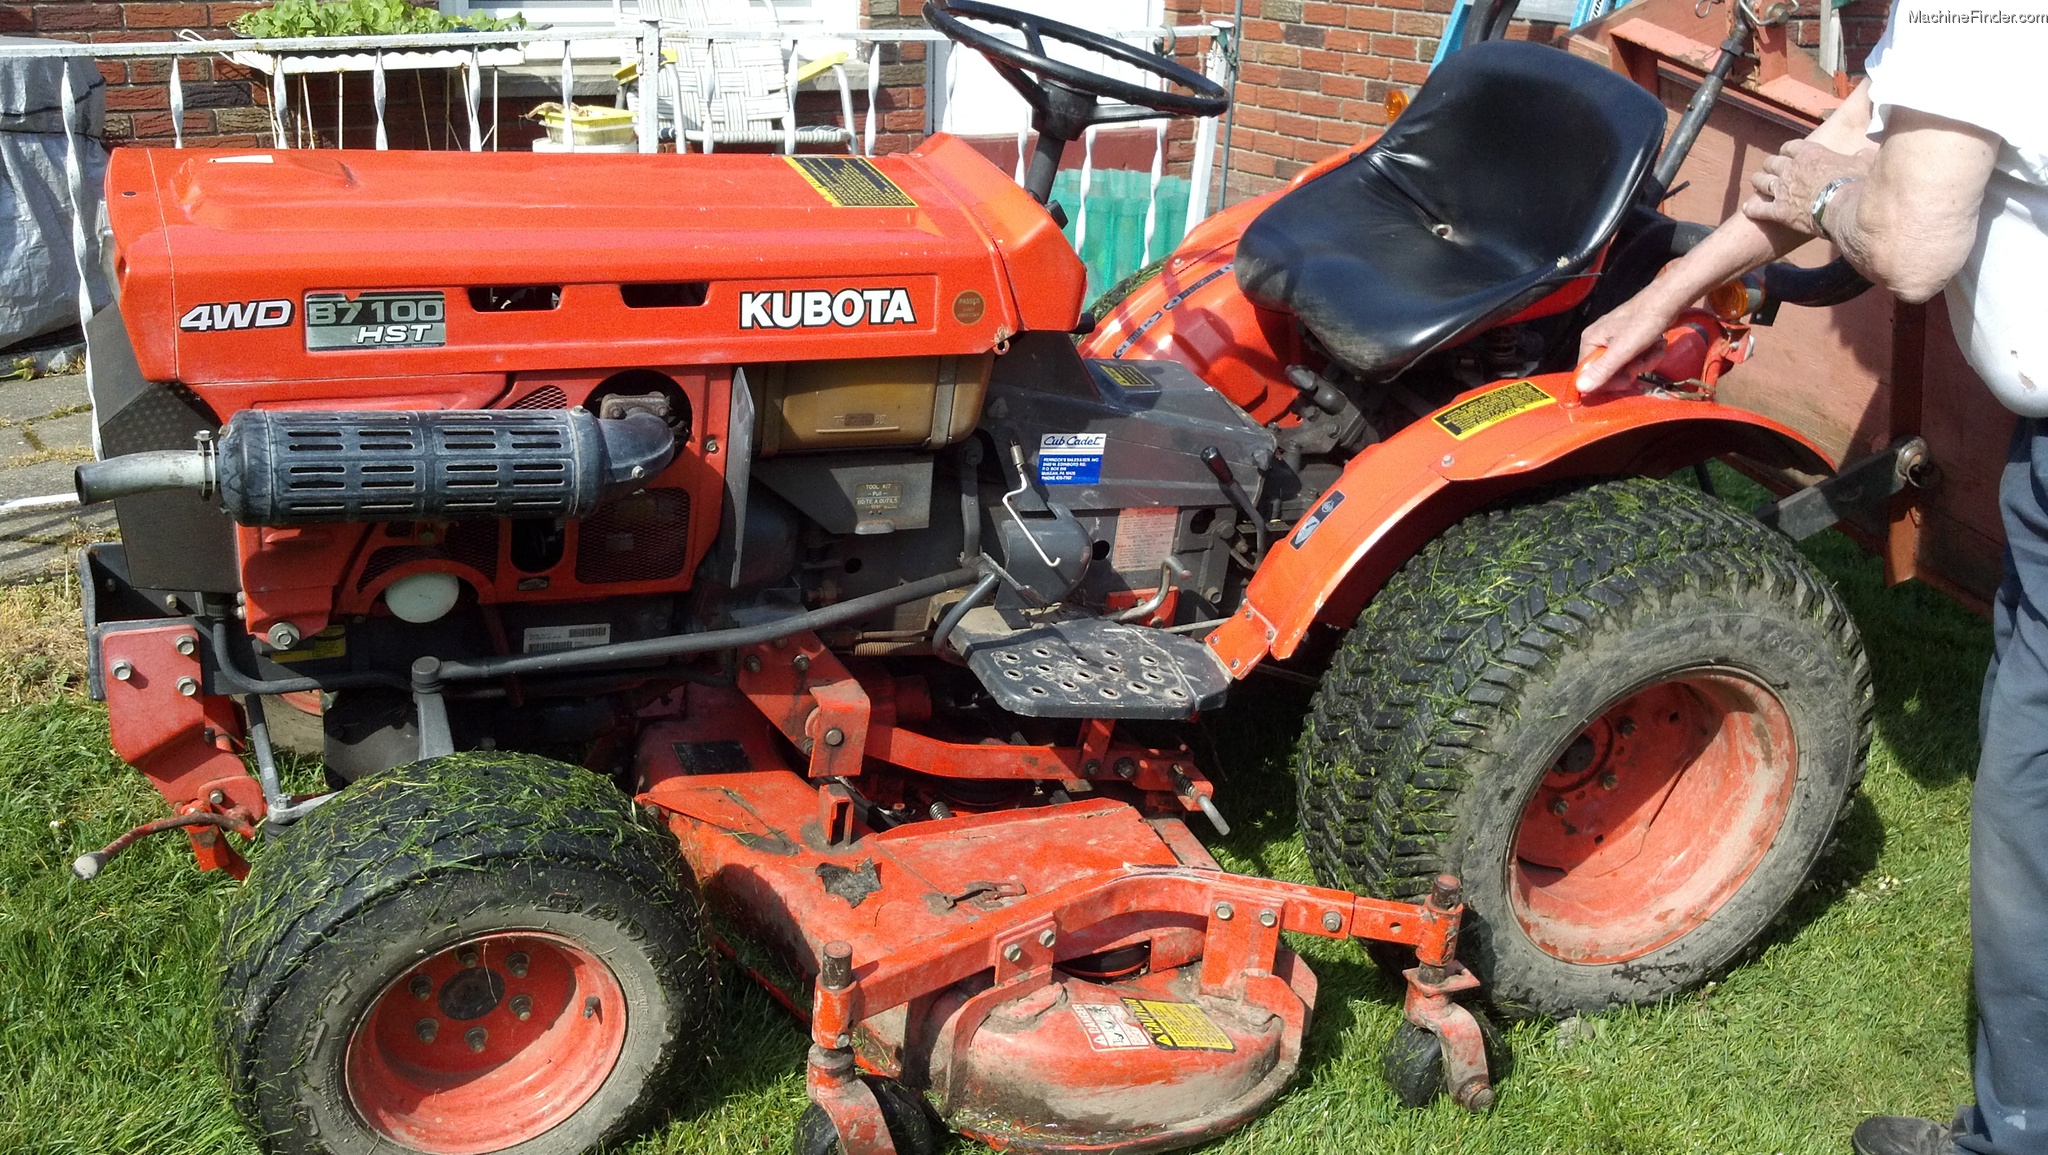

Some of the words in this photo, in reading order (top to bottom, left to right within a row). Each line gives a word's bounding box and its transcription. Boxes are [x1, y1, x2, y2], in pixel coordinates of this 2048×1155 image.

[179, 299, 295, 332] 4WD
[309, 300, 444, 324] B7100
[739, 287, 917, 329] KUBOTA
[356, 323, 433, 343] HST
[1043, 435, 1066, 446] Cub
[1066, 435, 1104, 446] Cadet
